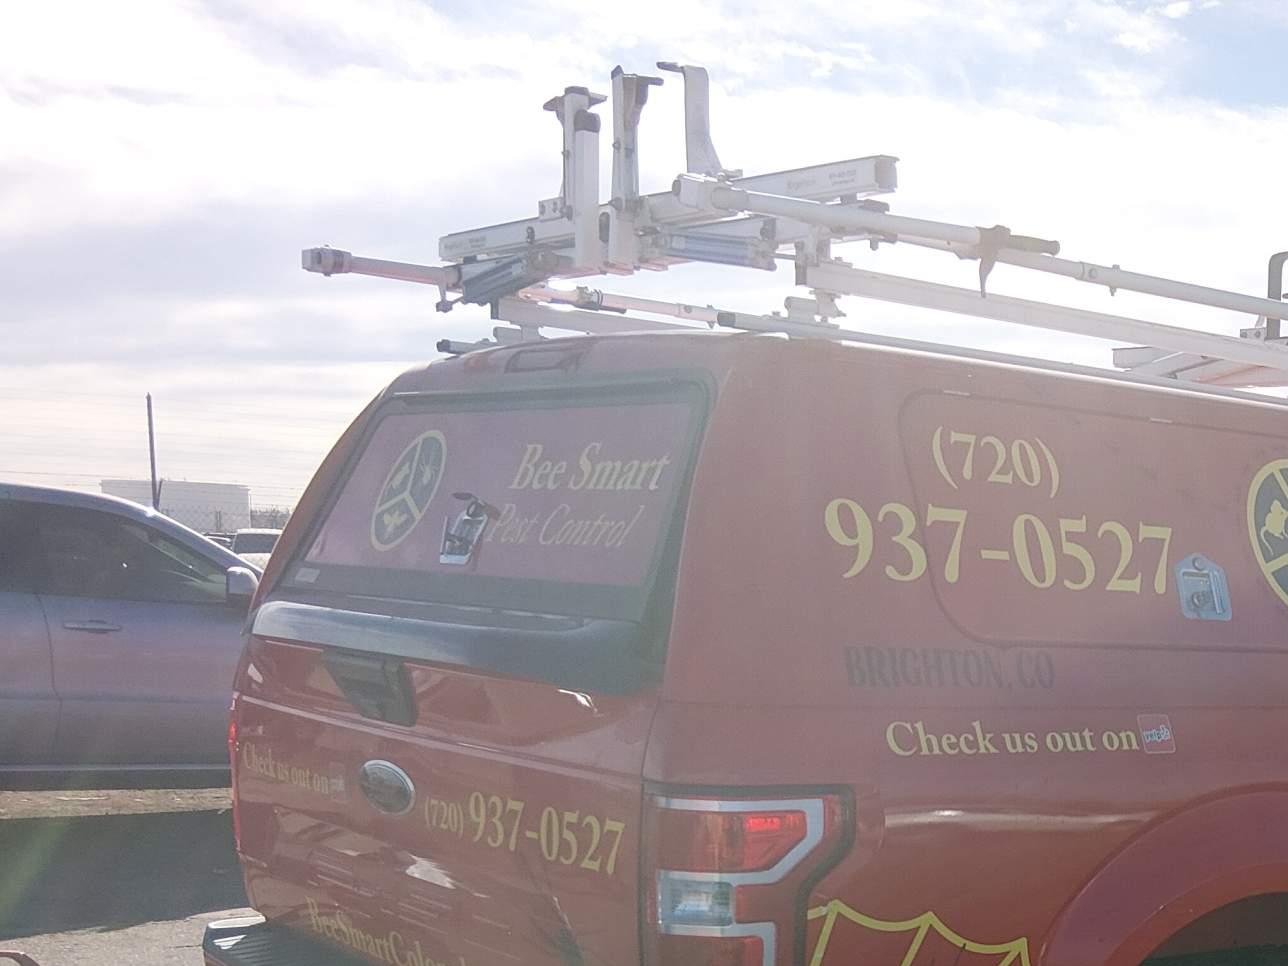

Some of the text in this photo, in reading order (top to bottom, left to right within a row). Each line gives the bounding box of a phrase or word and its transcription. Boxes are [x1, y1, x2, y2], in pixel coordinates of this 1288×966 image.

[508, 441, 672, 492] Bee Smart
[931, 426, 1060, 498] (720)
[483, 504, 646, 548] Pest Control
[824, 498, 1172, 596] 937-0527
[885, 720, 999, 757] Check
[1003, 729, 1038, 755] us
[1046, 724, 1096, 753] out
[1103, 727, 1140, 752] on
[424, 791, 626, 876] (720) 937-0527
